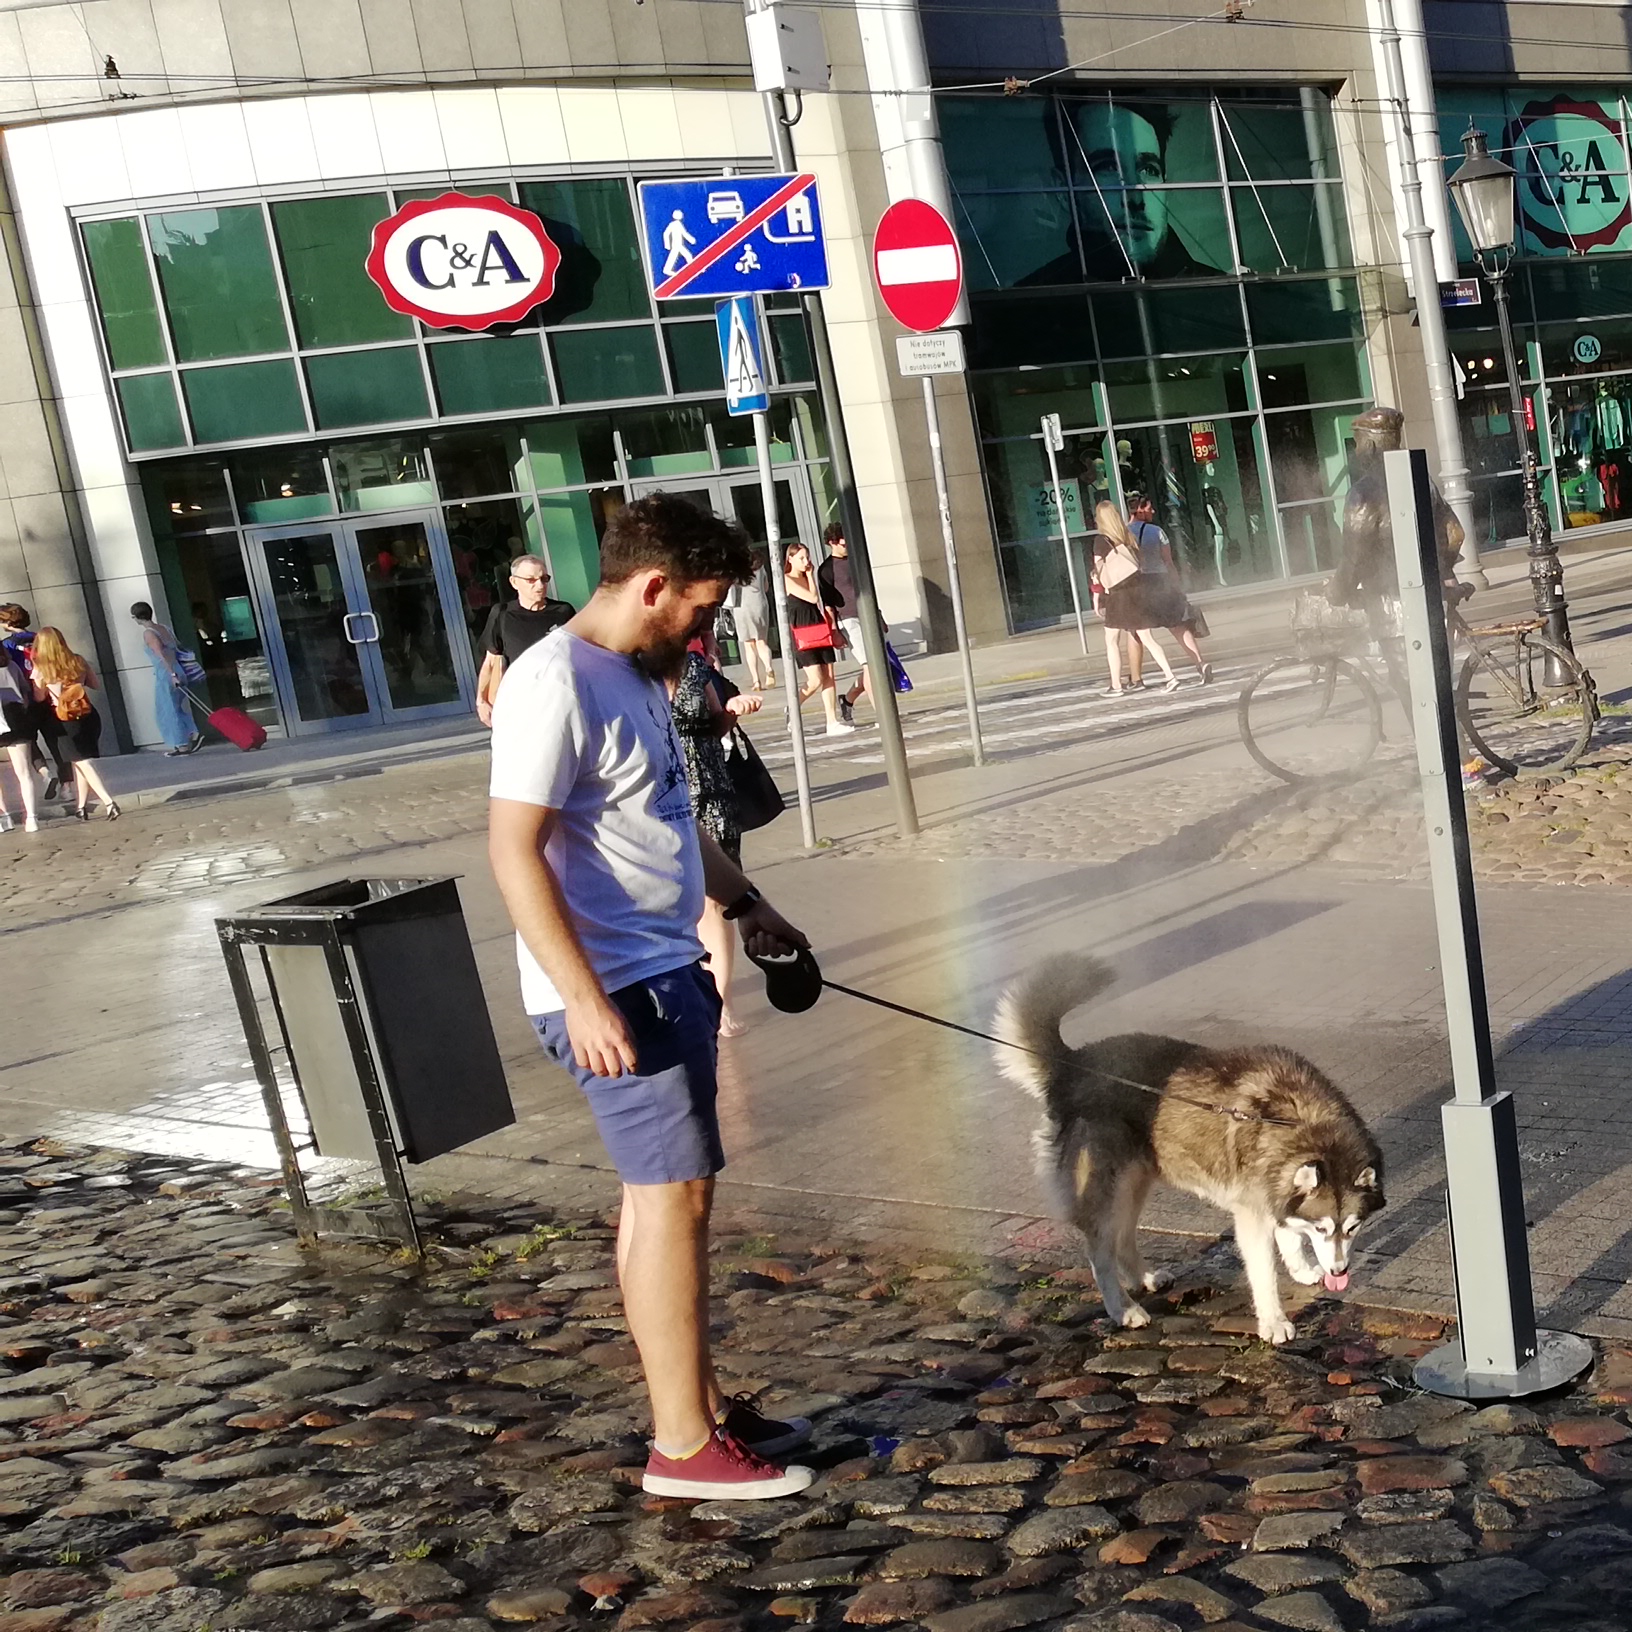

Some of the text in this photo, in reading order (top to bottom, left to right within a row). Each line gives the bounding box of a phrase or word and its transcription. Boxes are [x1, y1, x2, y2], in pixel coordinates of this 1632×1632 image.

[1525, 139, 1621, 207] C&A
[405, 229, 531, 291] C&A
[1577, 340, 1599, 358] C&A
[943, 360, 957, 368] MPK
[1195, 445, 1209, 458] 39
[1034, 487, 1075, 506] -20%
